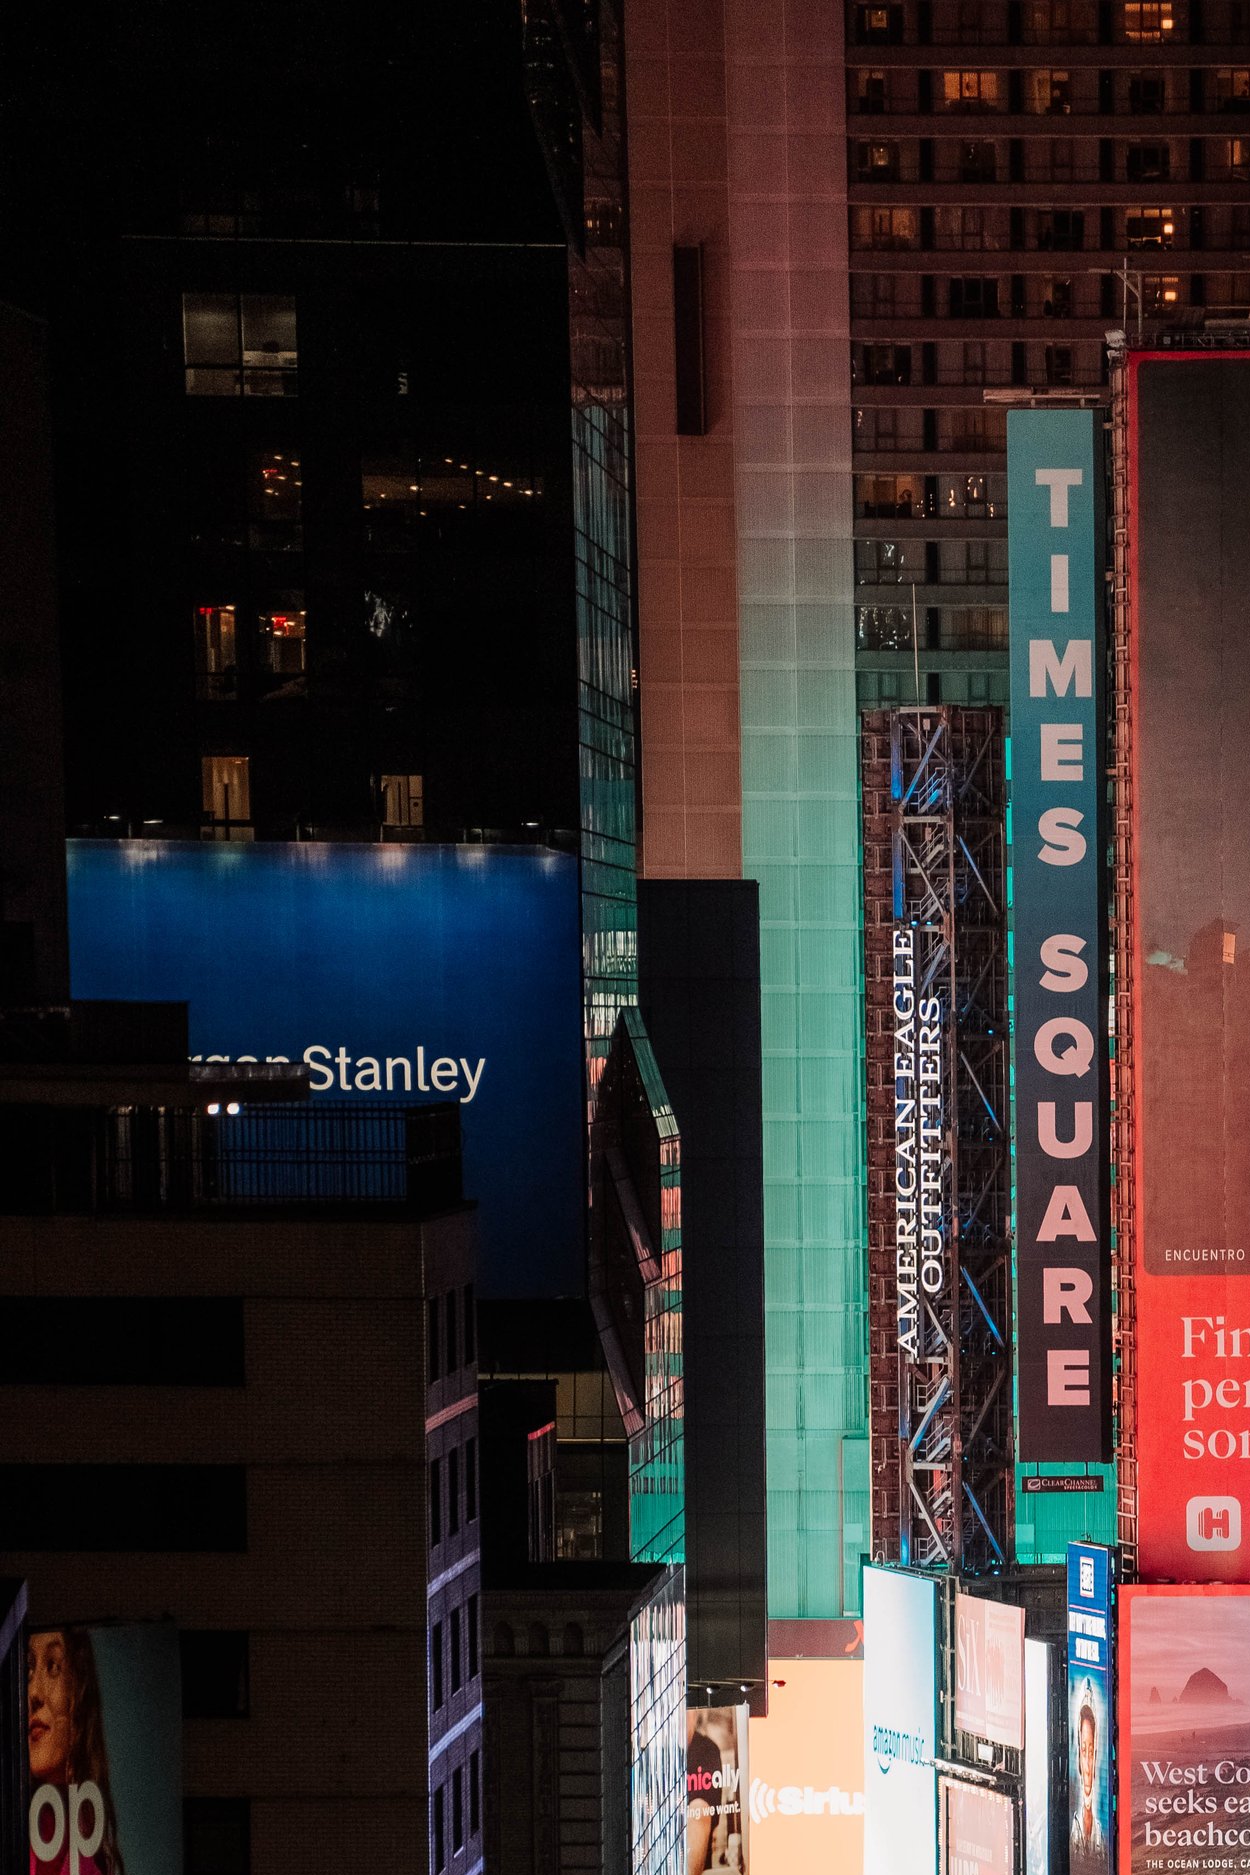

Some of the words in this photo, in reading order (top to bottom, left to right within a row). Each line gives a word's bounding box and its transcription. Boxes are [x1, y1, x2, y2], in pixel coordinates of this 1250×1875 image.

[1028, 467, 1093, 866] TIMES
[893, 928, 916, 1082] EAGLE
[303, 1045, 487, 1103] Stanley
[919, 996, 943, 1294] OUTFITTERS
[1032, 934, 1098, 1406] SQUARE
[895, 1098, 919, 1358] AMERICAN
[1165, 1248, 1246, 1262] ENCUENTRO
[873, 1724, 901, 1762] amazon
[1140, 1760, 1209, 1785] West
[716, 1801, 741, 1816] want.
[1145, 1788, 1218, 1814] seeks
[1146, 1859, 1165, 1869] THE
[1167, 1859, 1200, 1869] OCEAN
[1202, 1859, 1237, 1870] LODGE,
